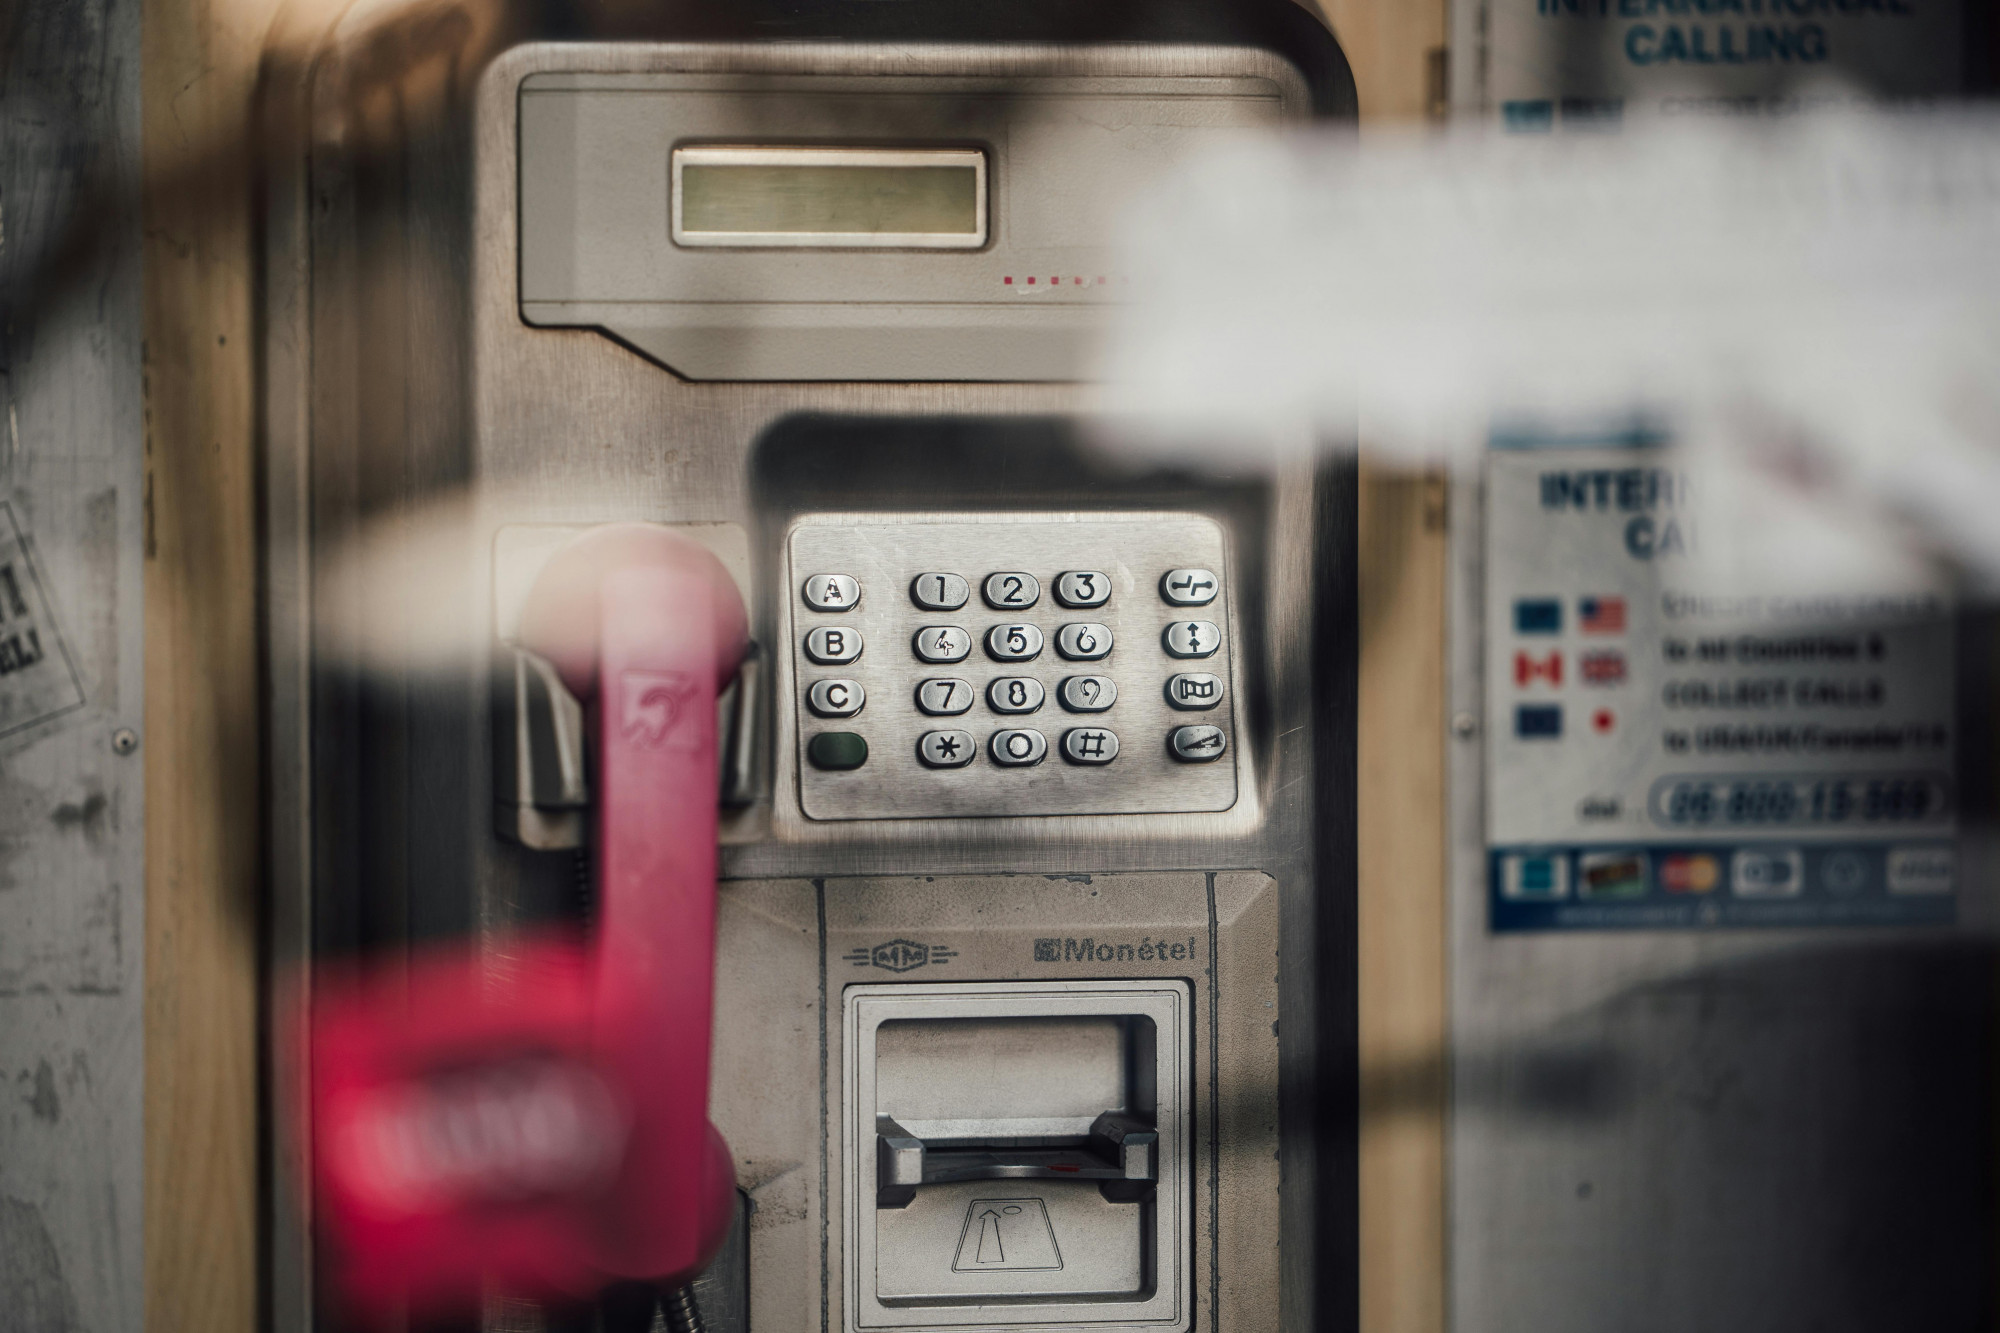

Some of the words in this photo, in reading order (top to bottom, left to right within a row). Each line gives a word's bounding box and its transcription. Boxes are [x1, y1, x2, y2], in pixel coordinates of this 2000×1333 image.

[1624, 24, 1827, 64] CALLING
[824, 577, 843, 603] A
[935, 576, 946, 603] 1
[1003, 576, 1023, 603] 2
[1076, 573, 1095, 601] 3
[826, 631, 845, 656] B
[935, 631, 954, 656] 4
[1007, 626, 1027, 654] 5
[1076, 626, 1097, 654] 6
[826, 683, 849, 709] C
[936, 682, 957, 709] 7
[1008, 680, 1027, 707] 8
[1081, 678, 1101, 706] 9
[1663, 679, 1788, 709] COLLECT
[1006, 732, 1032, 760] 0
[1064, 936, 1196, 962] Monétel
